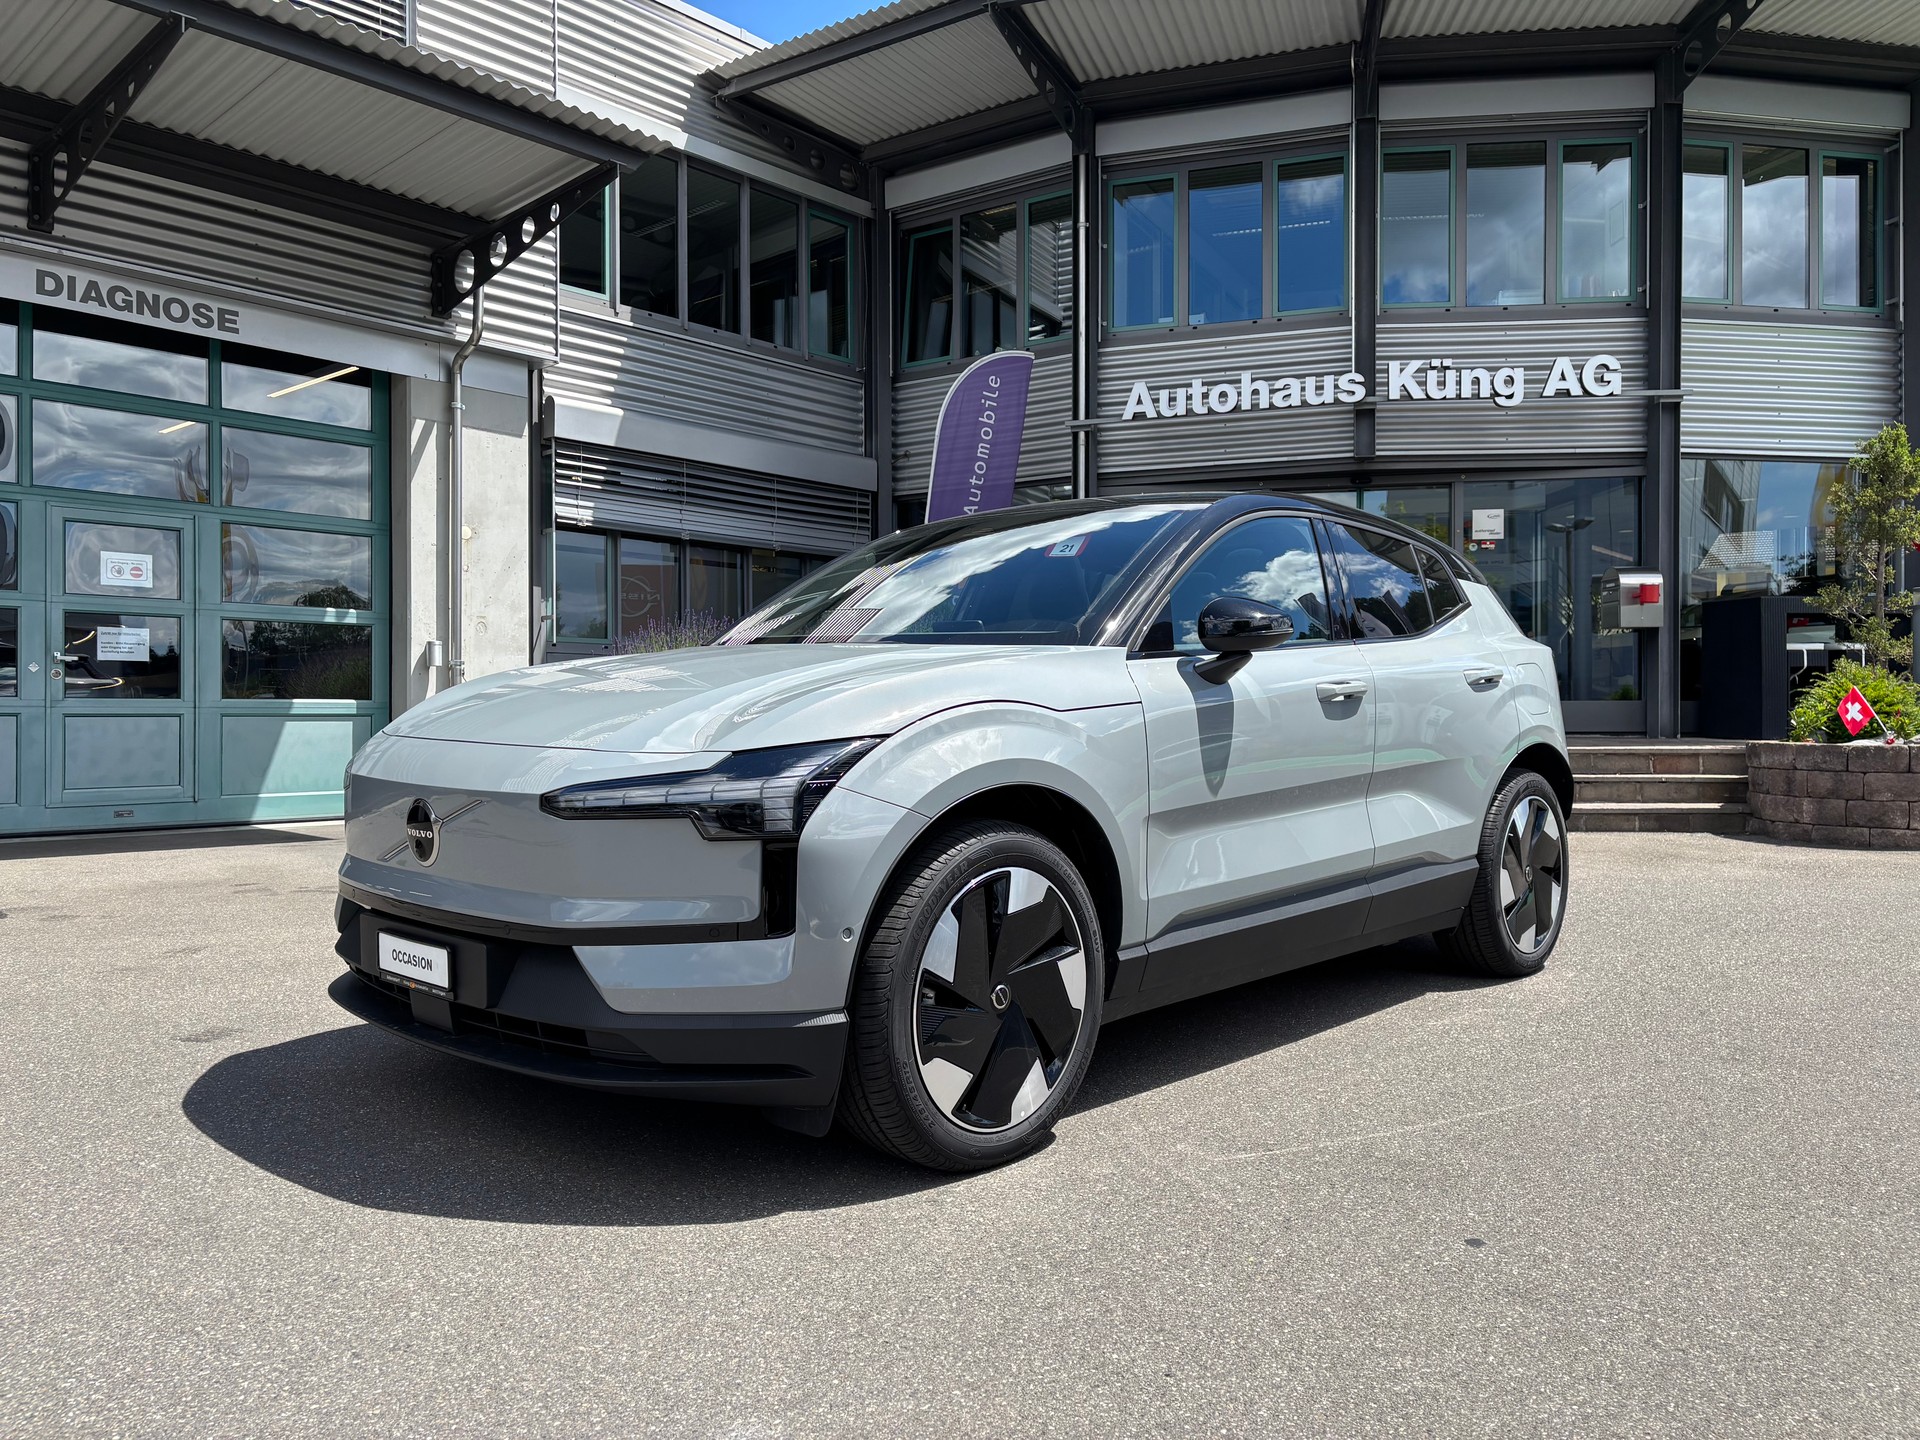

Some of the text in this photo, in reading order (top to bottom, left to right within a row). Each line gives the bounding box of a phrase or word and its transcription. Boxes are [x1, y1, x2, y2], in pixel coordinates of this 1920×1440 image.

[35, 268, 240, 334] DIAGNOSE
[1121, 354, 1622, 421] Autohaus Küng AG
[963, 375, 1001, 516] Automobile
[1059, 544, 1075, 553] 21
[407, 828, 433, 839] VOLVO
[912, 860, 969, 942] GOODYEAR
[391, 948, 433, 971] OCCASION
